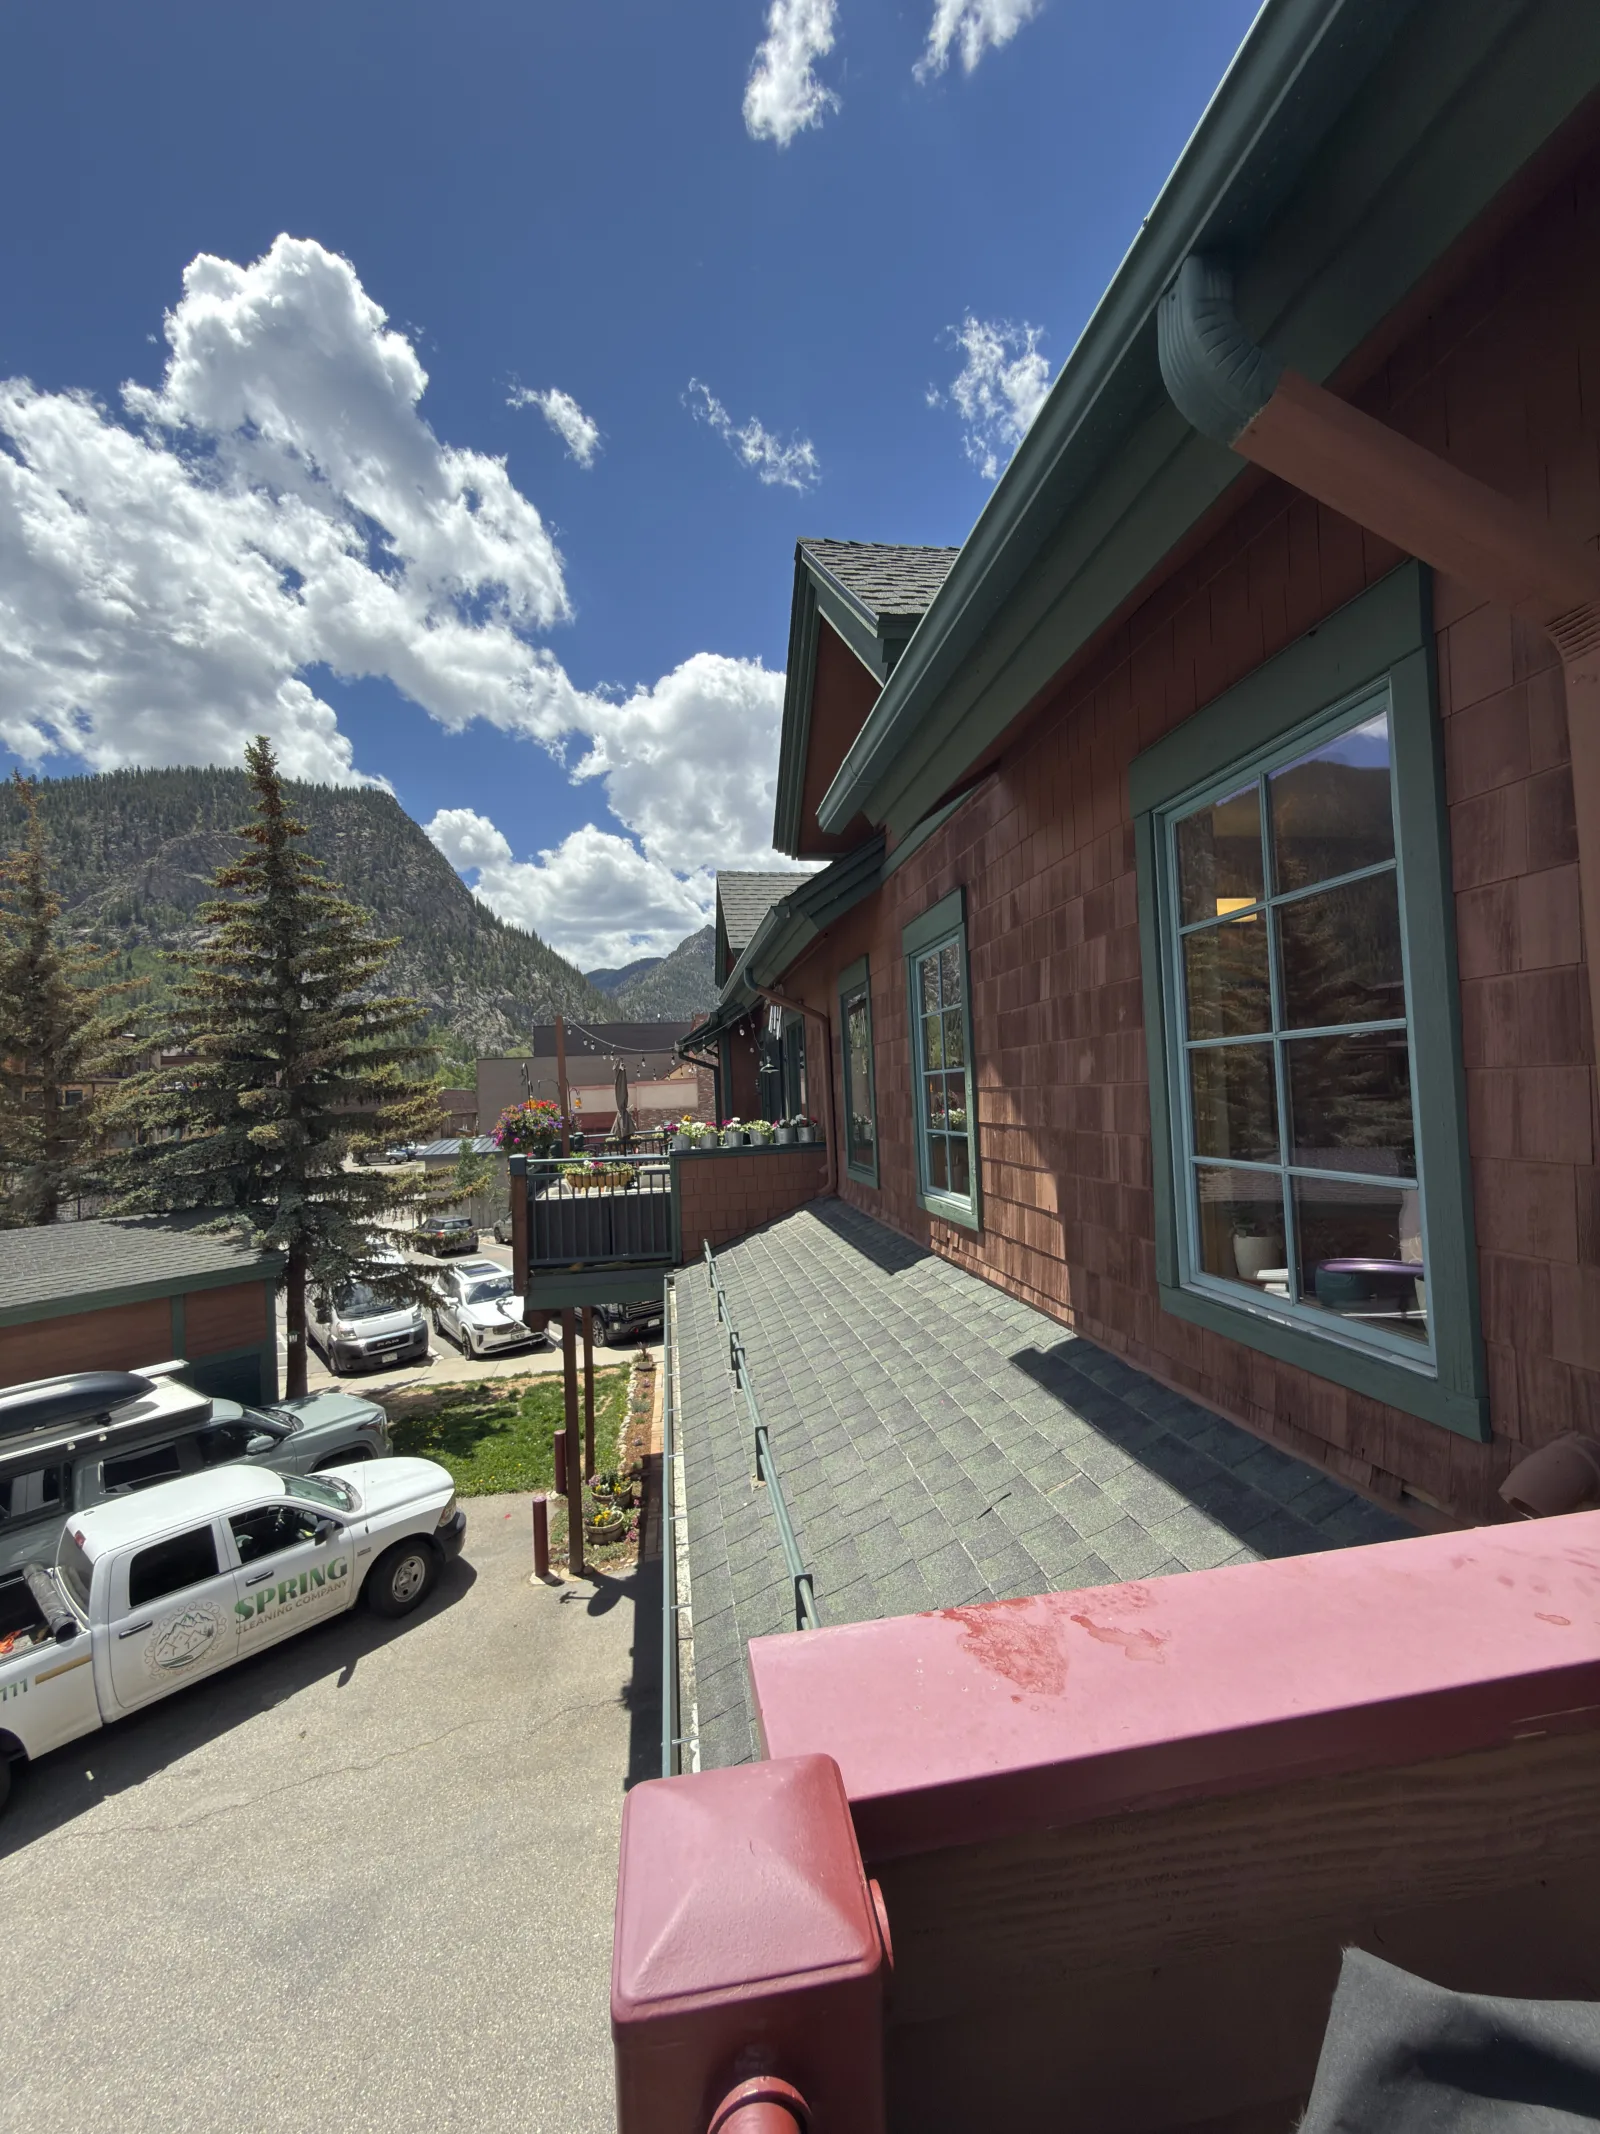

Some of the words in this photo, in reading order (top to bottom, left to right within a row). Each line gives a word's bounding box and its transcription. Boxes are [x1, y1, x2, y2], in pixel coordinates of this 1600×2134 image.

[234, 1556, 348, 1624] SPRING
[235, 1603, 293, 1635] CLEANING
[295, 1579, 347, 1608] COMPANY
